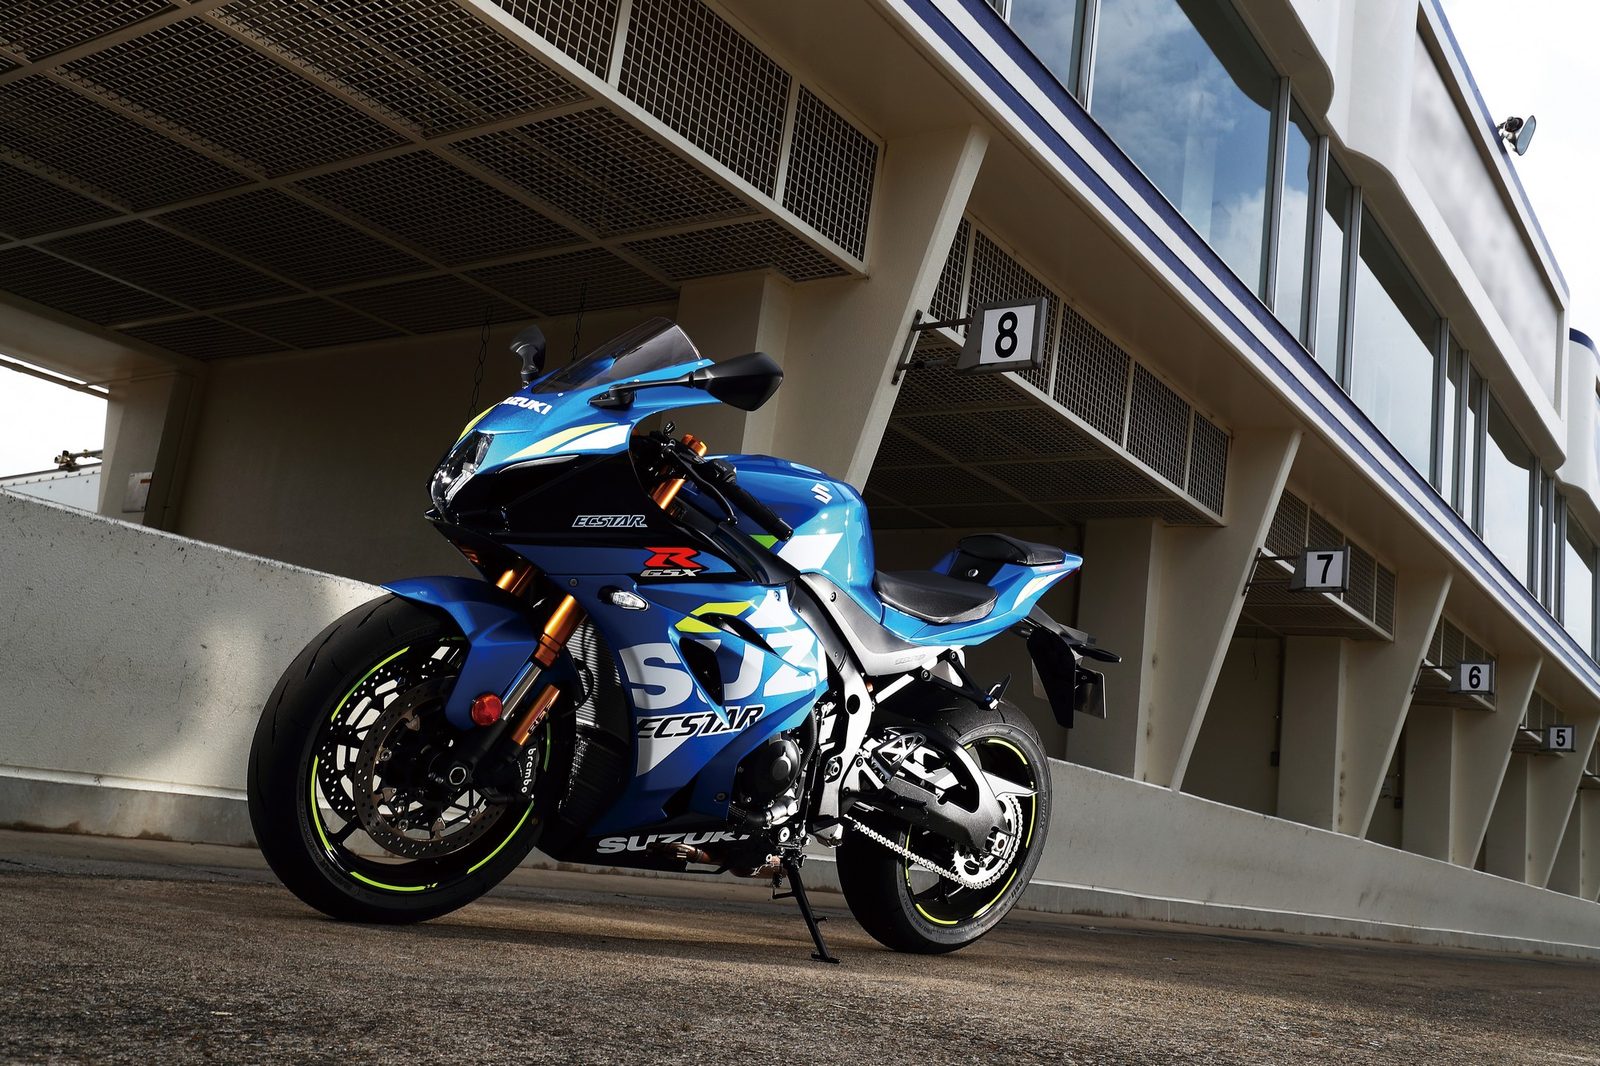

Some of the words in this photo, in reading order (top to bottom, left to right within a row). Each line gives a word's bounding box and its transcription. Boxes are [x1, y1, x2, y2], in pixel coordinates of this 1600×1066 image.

[995, 311, 1018, 358] 8
[572, 515, 648, 528] ECSTAR
[644, 547, 704, 567] R
[640, 568, 702, 577] GSX
[1317, 554, 1334, 584] 7
[1468, 666, 1481, 689] 6
[637, 705, 764, 739] ECSTAR
[1555, 729, 1566, 747] 5
[521, 747, 537, 793] brembo
